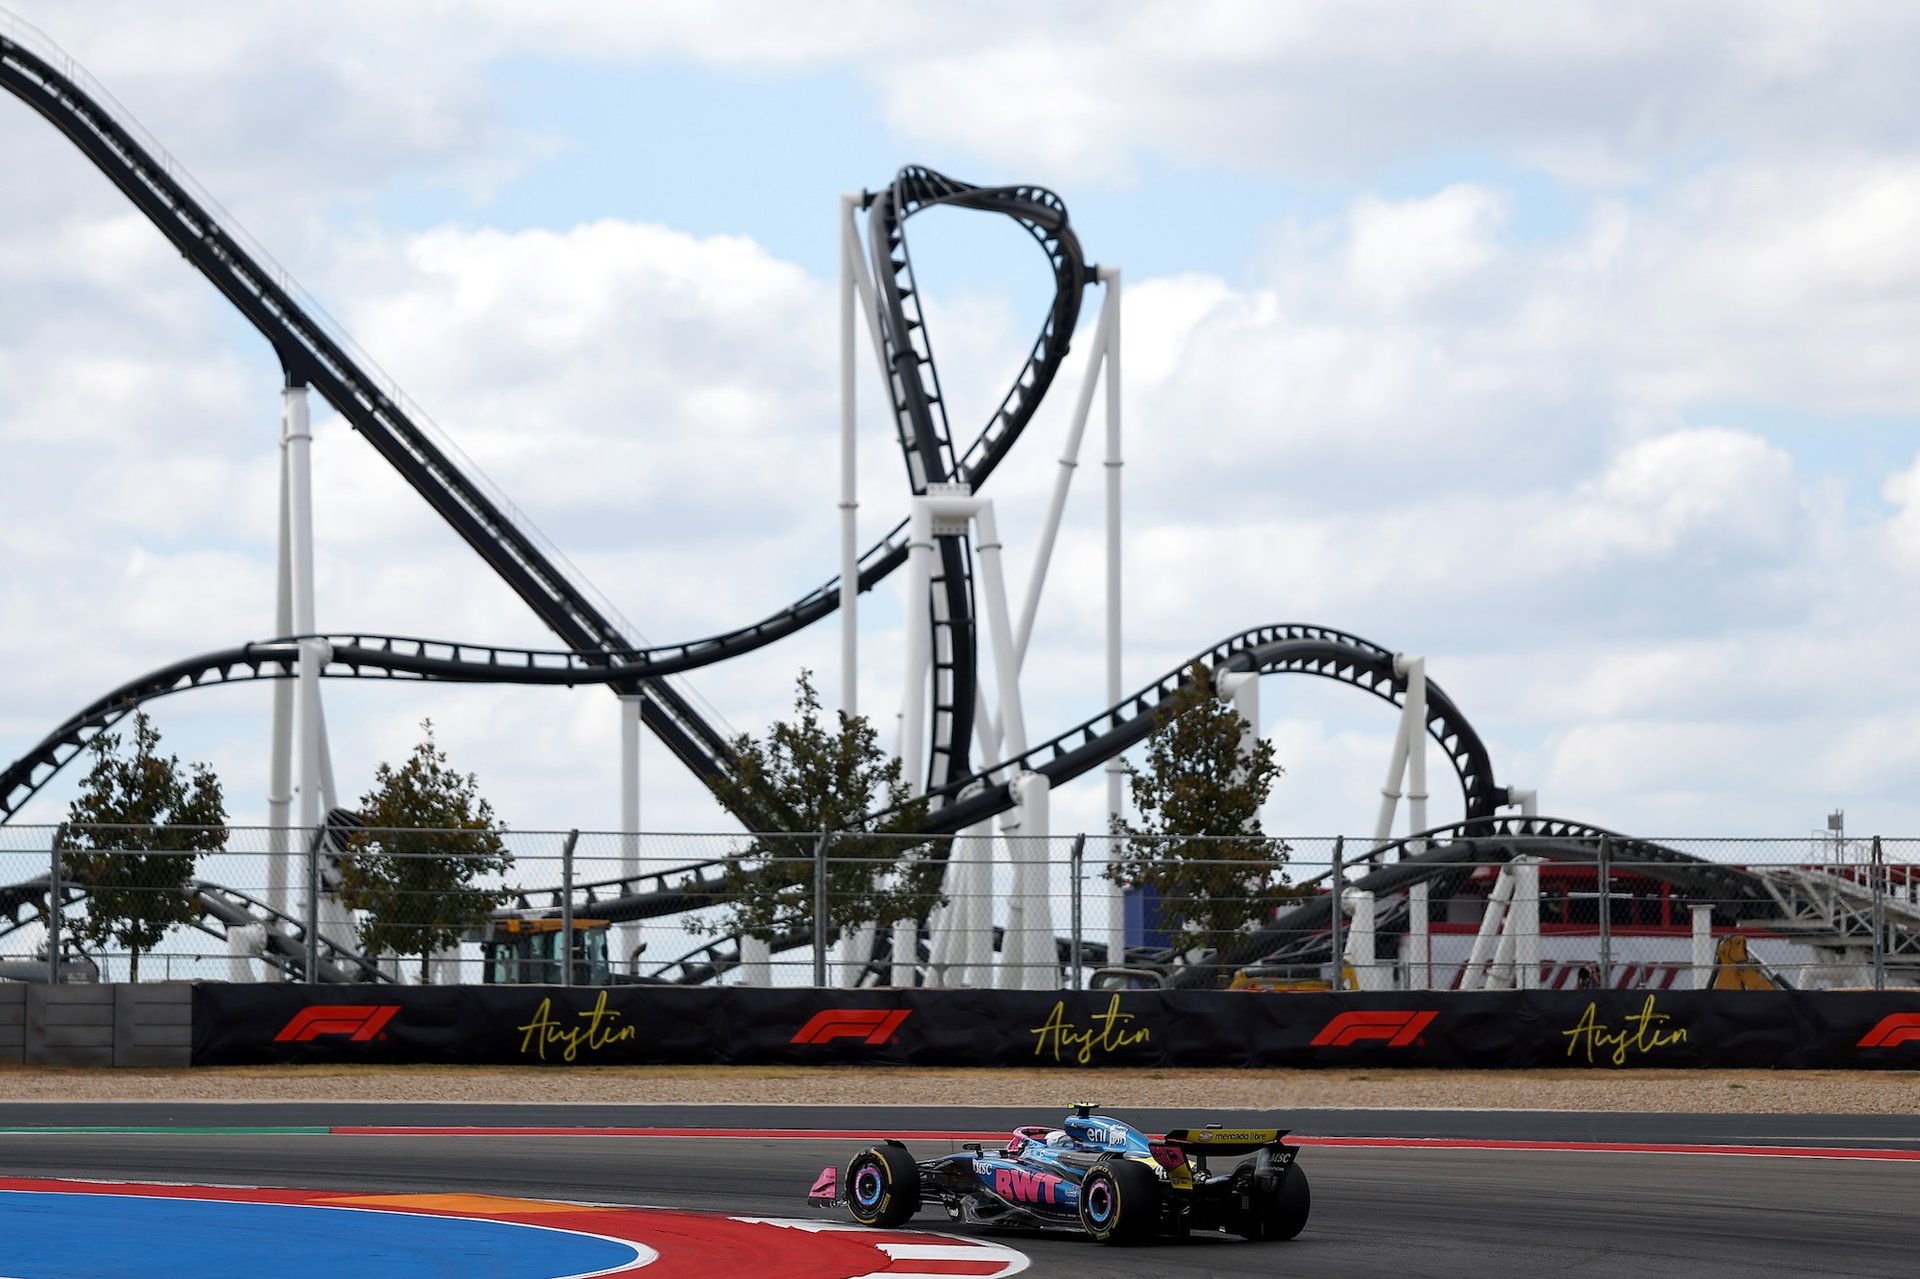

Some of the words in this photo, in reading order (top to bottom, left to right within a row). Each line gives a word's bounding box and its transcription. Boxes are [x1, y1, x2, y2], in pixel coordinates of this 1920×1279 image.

[518, 991, 637, 1063] Austin
[1031, 994, 1150, 1064] Austin
[1563, 995, 1687, 1064] Austin
[1087, 1128, 1106, 1142] eni
[1215, 1132, 1249, 1141] mercado
[1250, 1132, 1267, 1140] libre
[972, 1159, 993, 1175] MSC
[1269, 1152, 1291, 1163] MSC
[995, 1168, 1063, 1204] BWT
